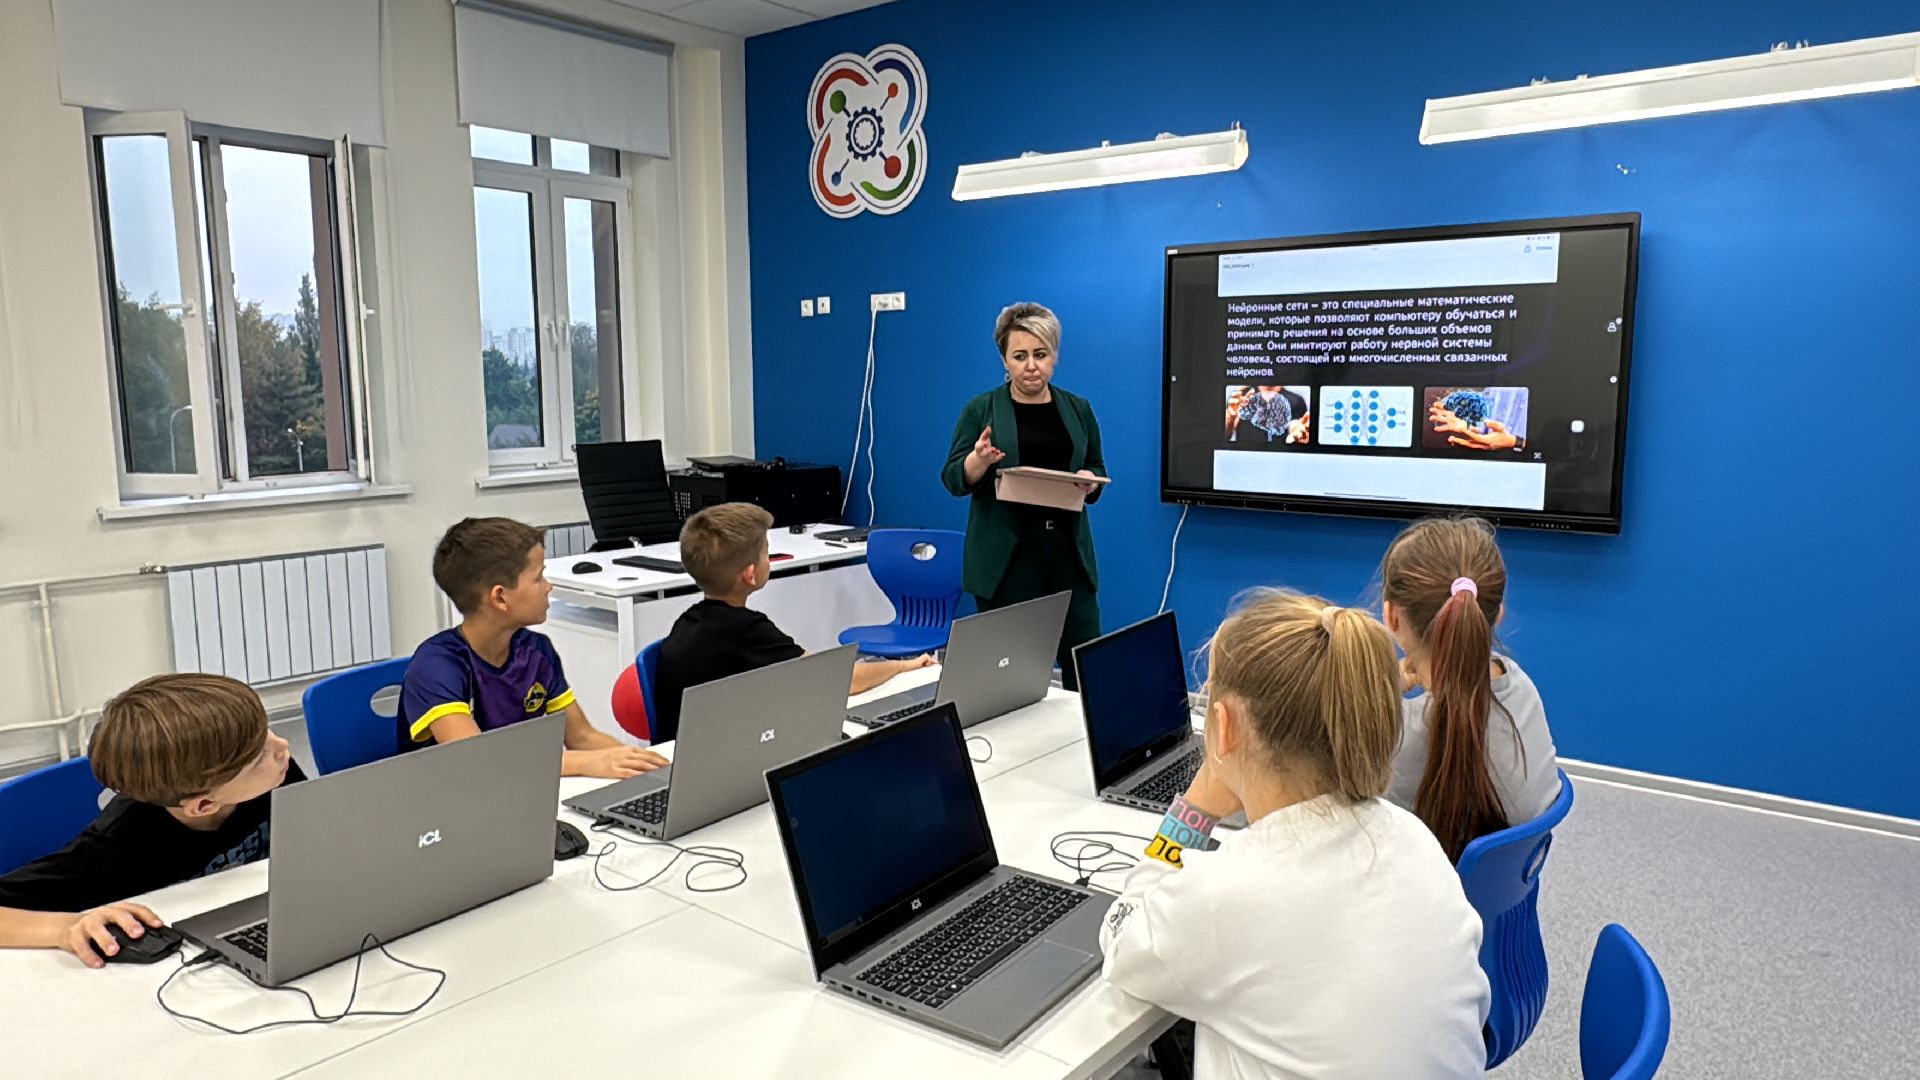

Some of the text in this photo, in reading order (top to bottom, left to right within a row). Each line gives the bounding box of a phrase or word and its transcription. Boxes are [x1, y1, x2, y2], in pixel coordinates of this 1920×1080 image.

[1228, 302, 1283, 314] Нейронные
[1286, 301, 1308, 311] сети
[1321, 301, 1339, 310] это
[1342, 298, 1414, 310] специальные
[1418, 295, 1515, 307] математические
[1227, 308, 1517, 327] модели, которые позволяют компьютеру обучаться и
[1227, 323, 1492, 340] принимать решения на основе больших объемов
[1267, 342, 1287, 351] Они
[1290, 341, 1348, 351] имитируют
[1351, 338, 1388, 351] работу
[1391, 337, 1439, 350] нервной
[1442, 338, 1492, 348] системы
[1226, 352, 1508, 365] человека, состоящей из многочисленных связанных
[1226, 366, 1274, 379] нейронов.
[418, 829, 442, 848] ICL
